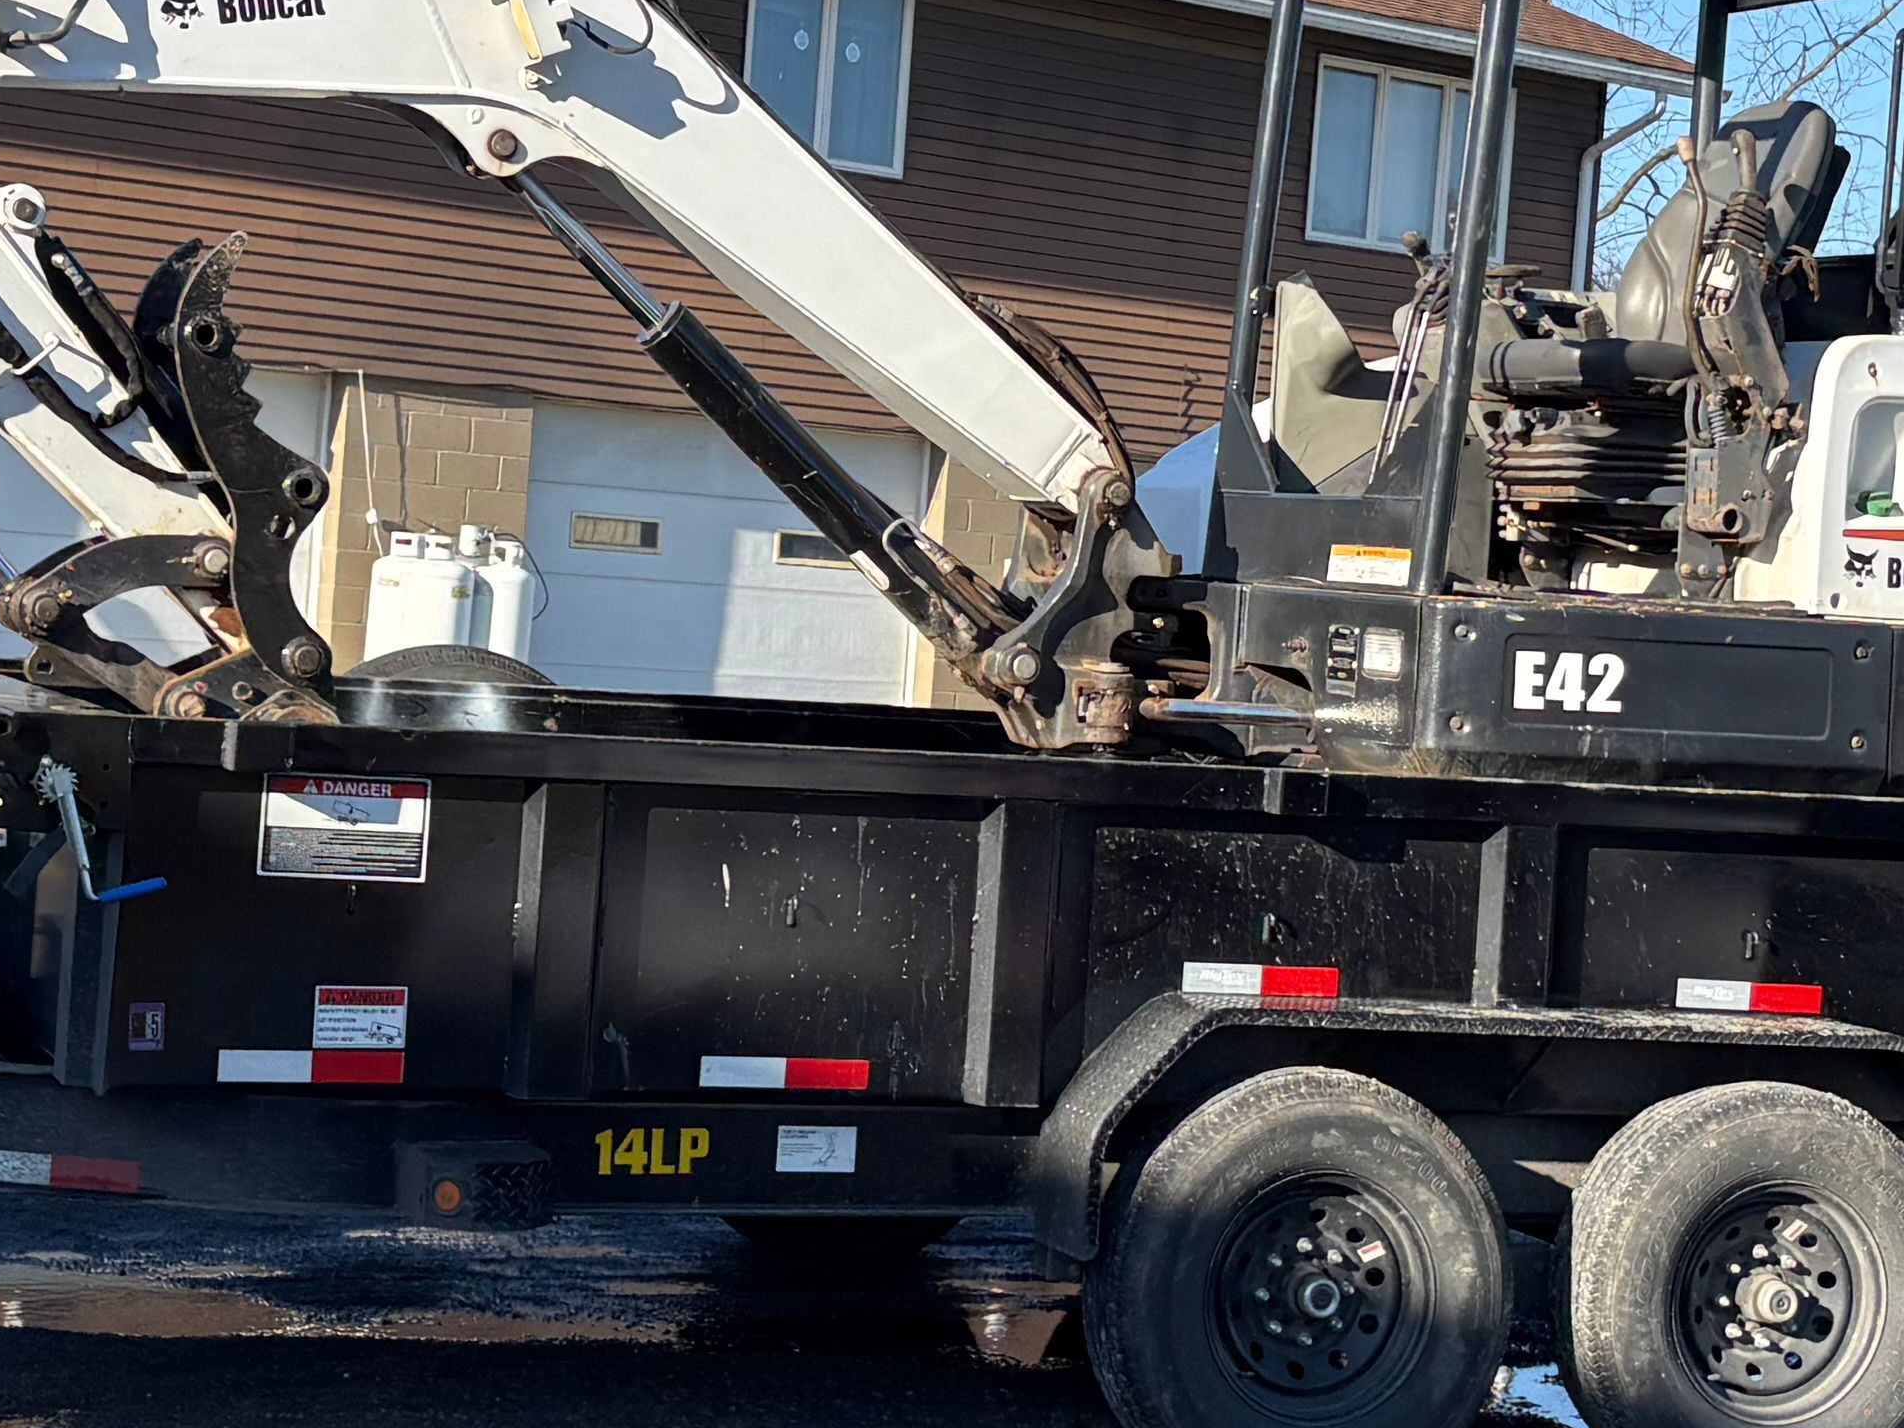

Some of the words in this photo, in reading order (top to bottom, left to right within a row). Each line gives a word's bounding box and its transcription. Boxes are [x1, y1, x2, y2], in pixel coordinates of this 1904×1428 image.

[1513, 650, 1625, 713] E42
[322, 780, 392, 797] DANGER
[595, 1127, 710, 1175] 14LP
